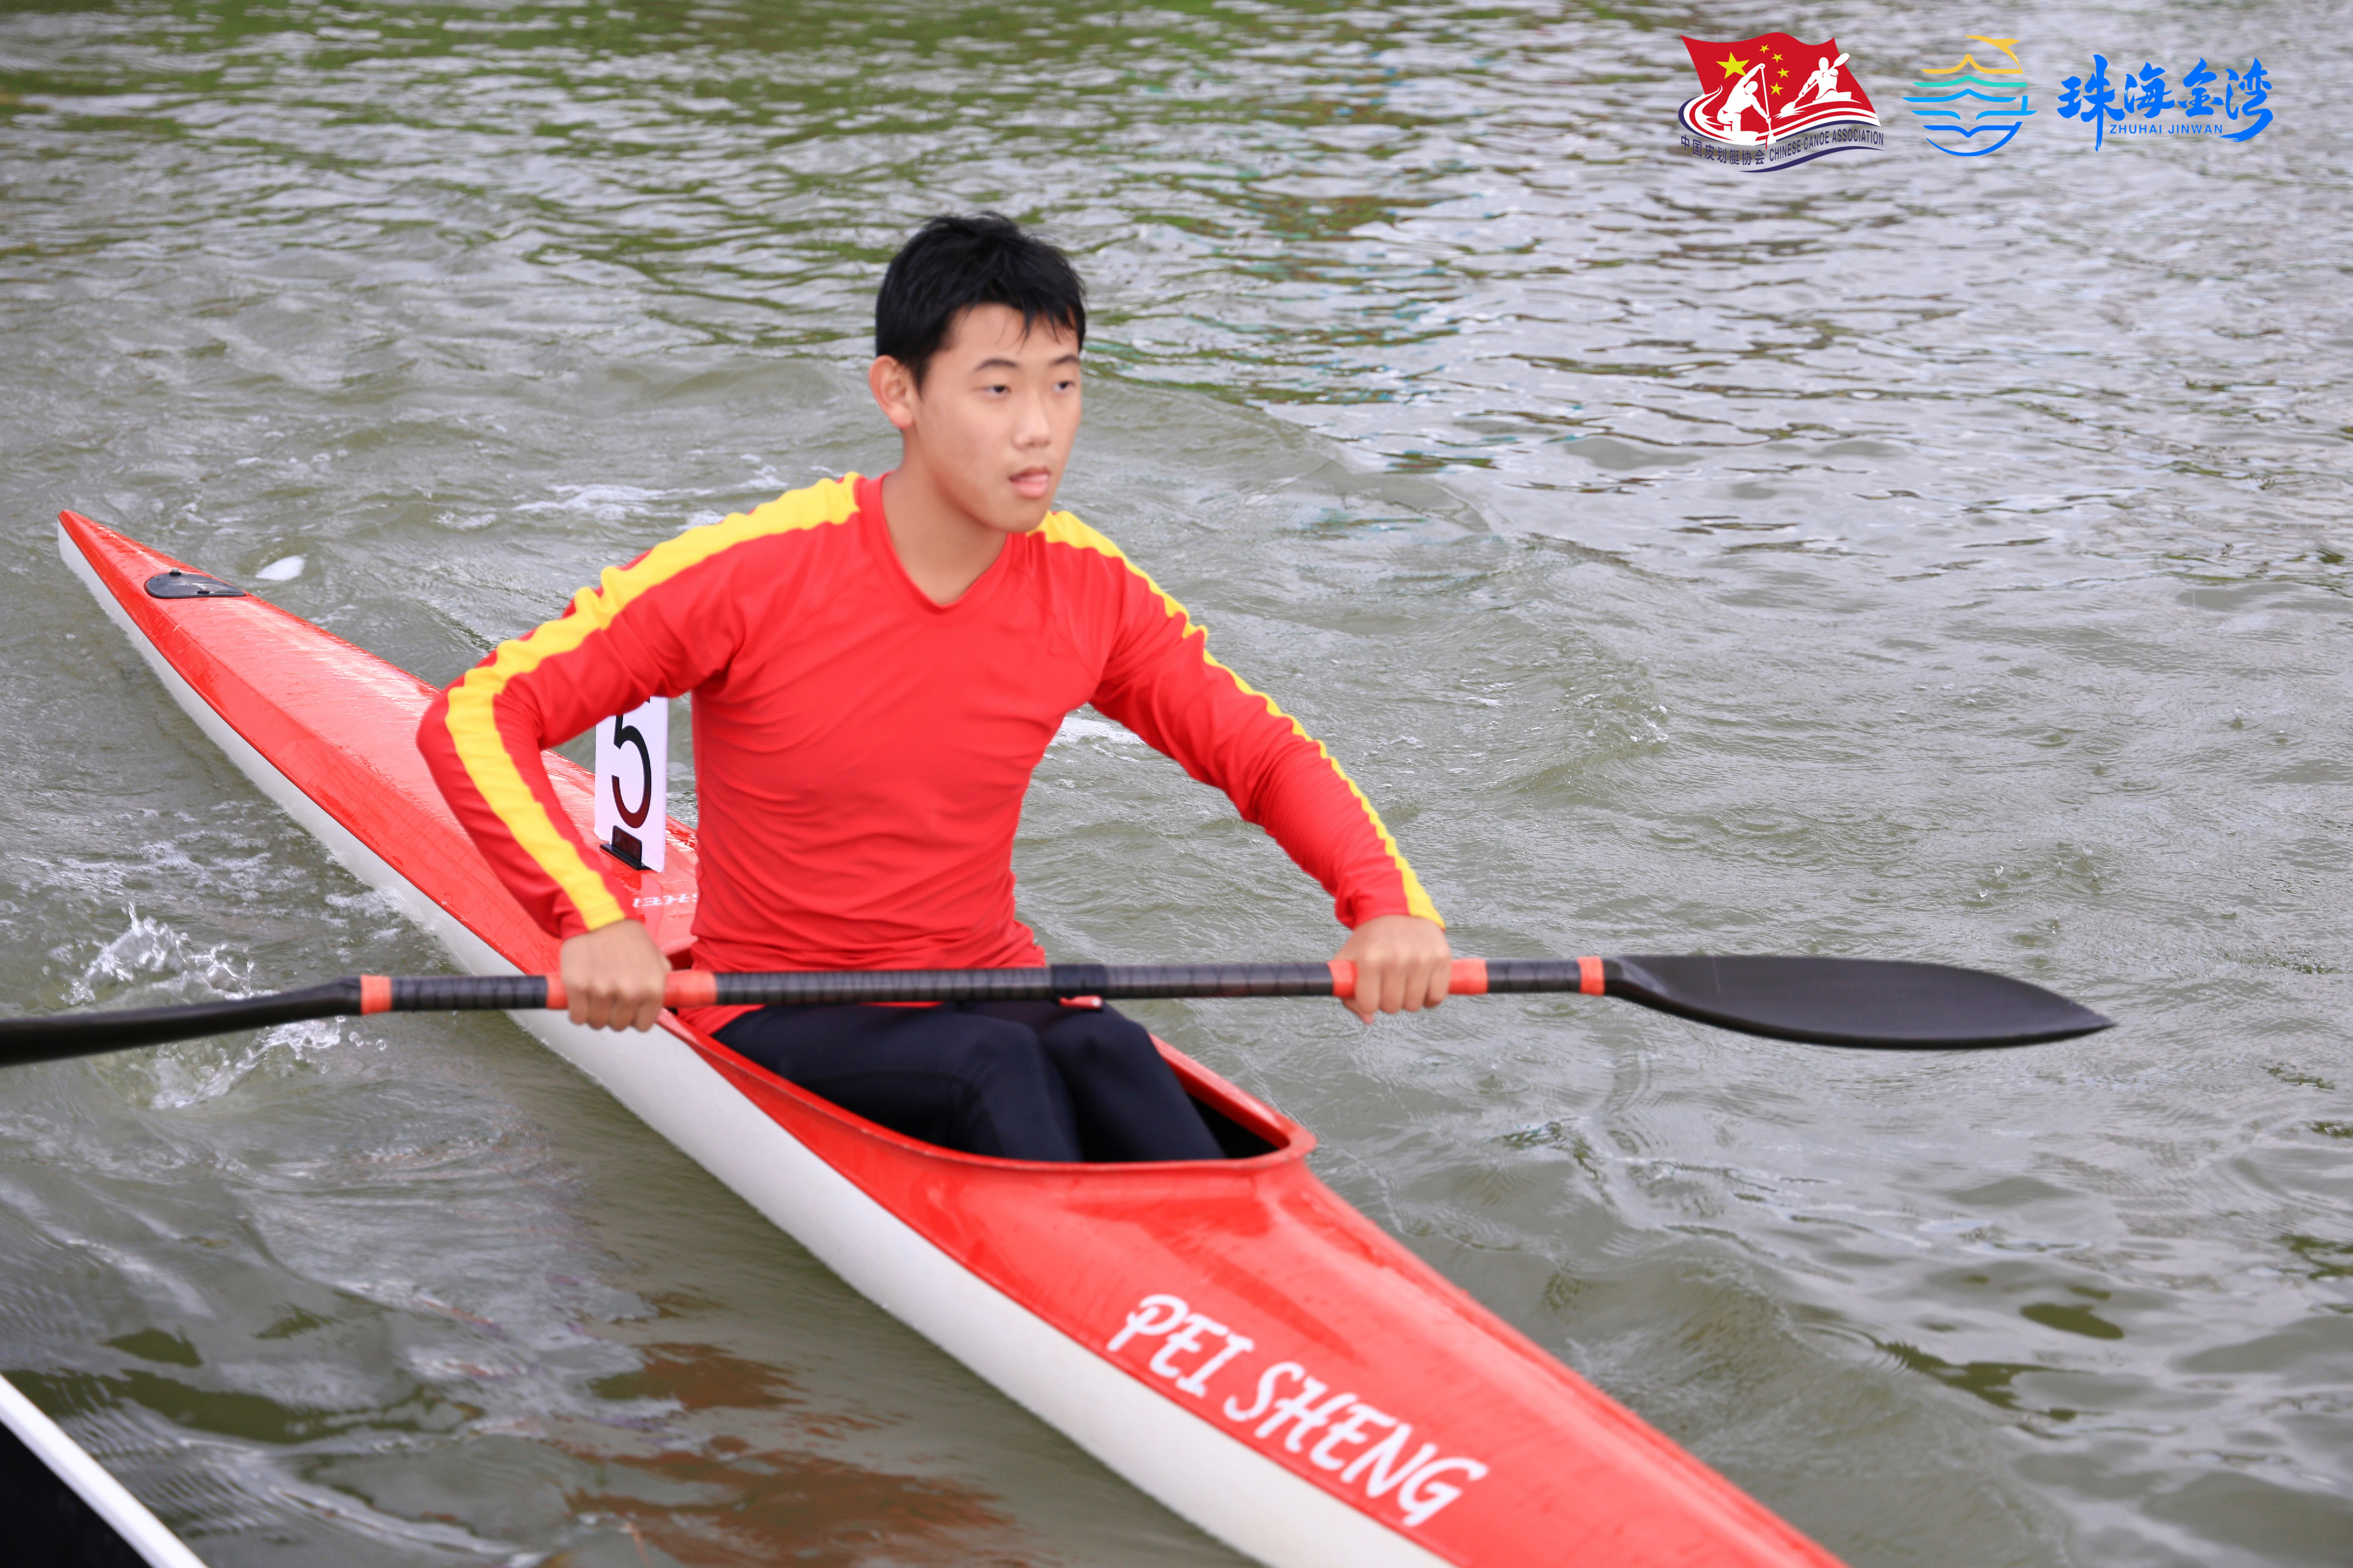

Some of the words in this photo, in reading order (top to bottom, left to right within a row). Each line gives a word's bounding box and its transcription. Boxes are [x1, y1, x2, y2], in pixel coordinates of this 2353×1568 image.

[611, 696, 652, 829] 5
[1107, 1294, 1254, 1398] PEI
[1223, 1361, 1489, 1527] SHENG
